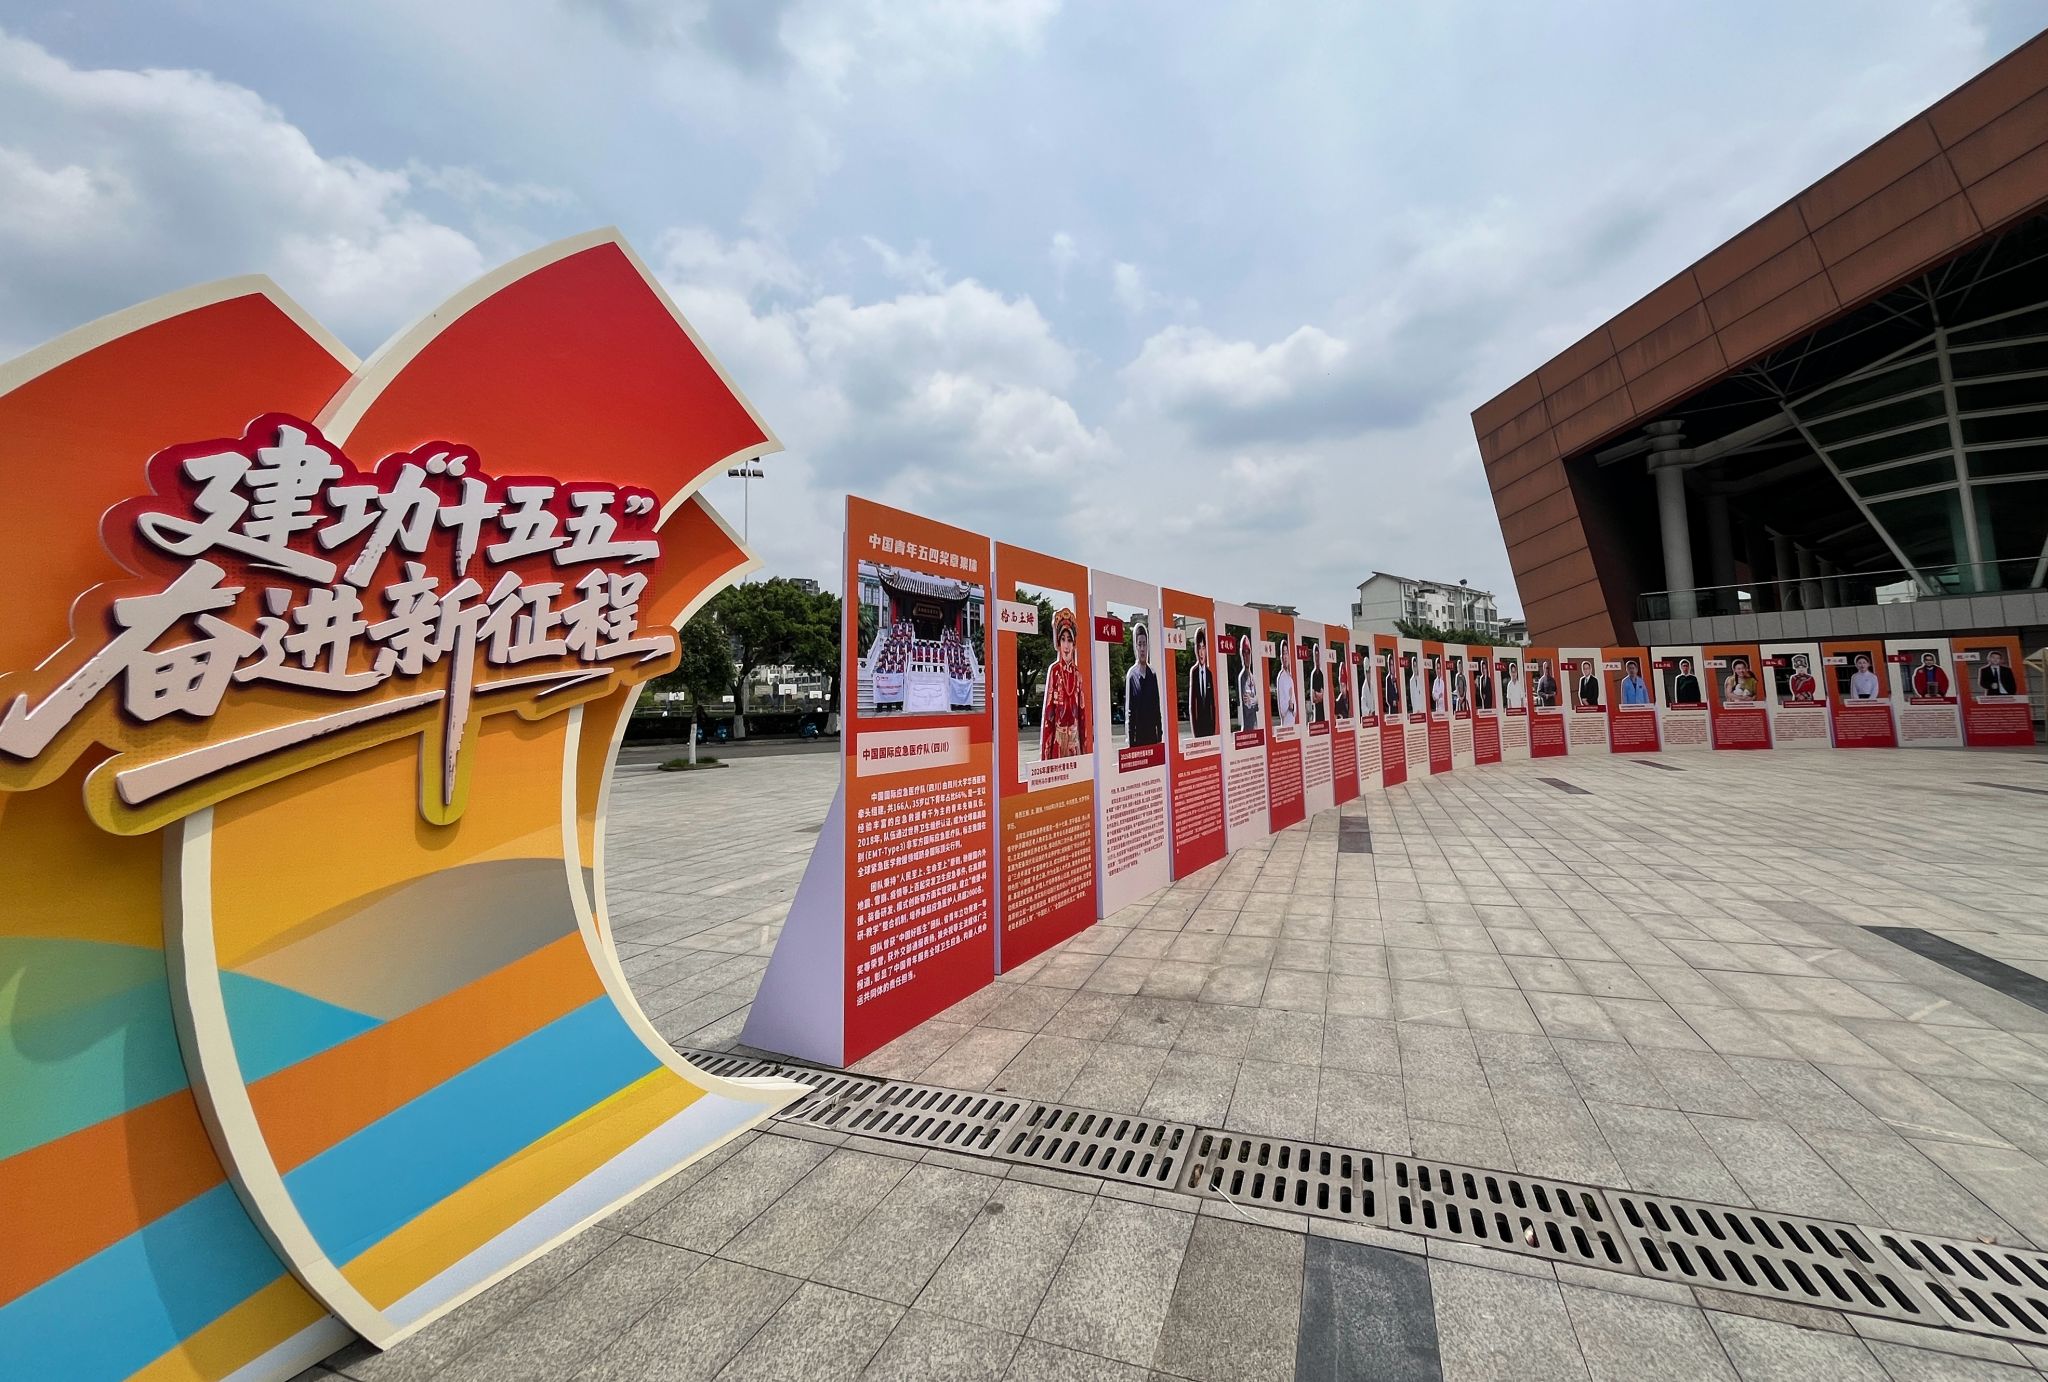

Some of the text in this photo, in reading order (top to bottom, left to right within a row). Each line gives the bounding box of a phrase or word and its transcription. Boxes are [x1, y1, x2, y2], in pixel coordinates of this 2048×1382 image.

[137, 424, 660, 588] 建功“十五五”
[0, 560, 675, 806] 奋进新征程
